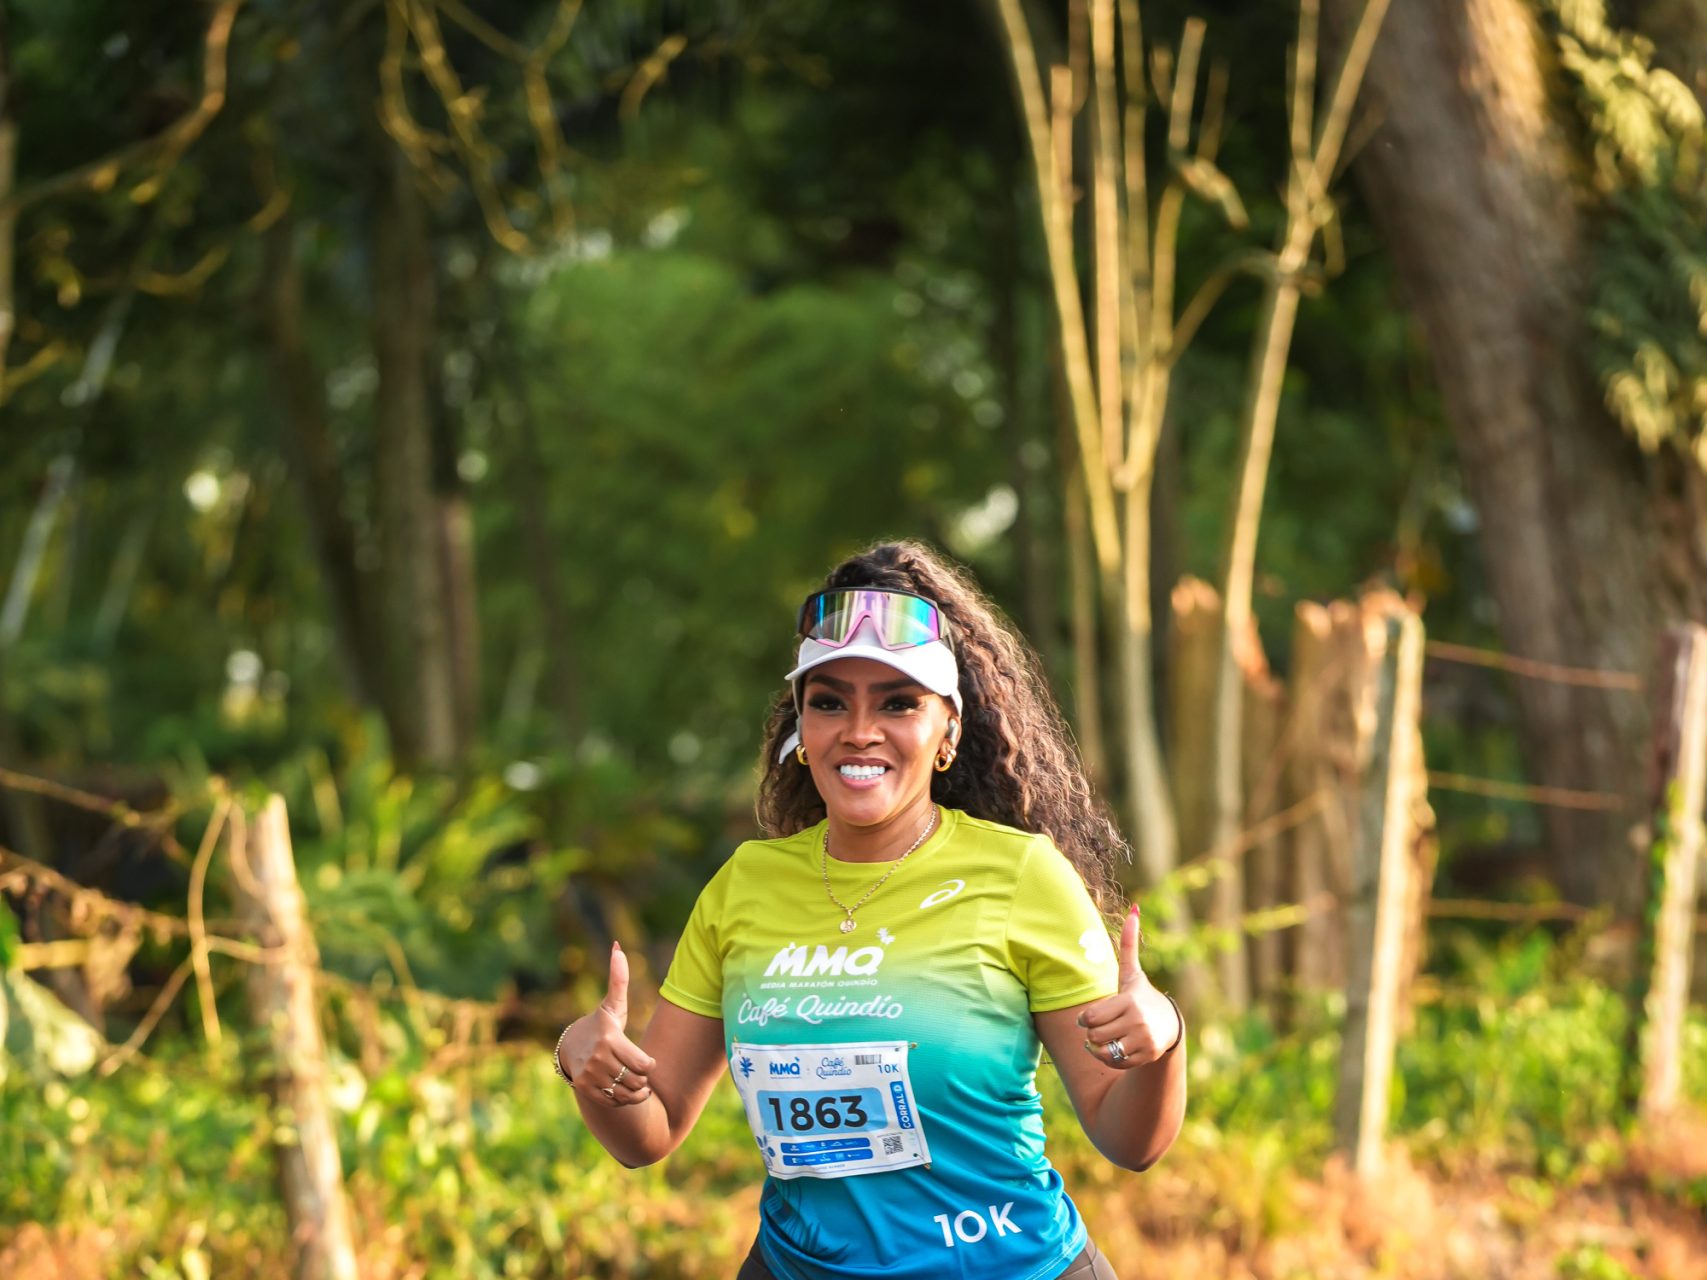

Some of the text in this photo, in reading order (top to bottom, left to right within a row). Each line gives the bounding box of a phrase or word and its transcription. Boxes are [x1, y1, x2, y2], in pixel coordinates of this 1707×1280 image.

[738, 995, 904, 1027] Café Quindío
[769, 1061, 801, 1075] MMQ
[821, 1057, 844, 1067] Café
[877, 1063, 900, 1074] 10K
[768, 1095, 868, 1131] 1863
[894, 1084, 911, 1129] CORRAL D
[933, 1201, 1023, 1248] 10K
